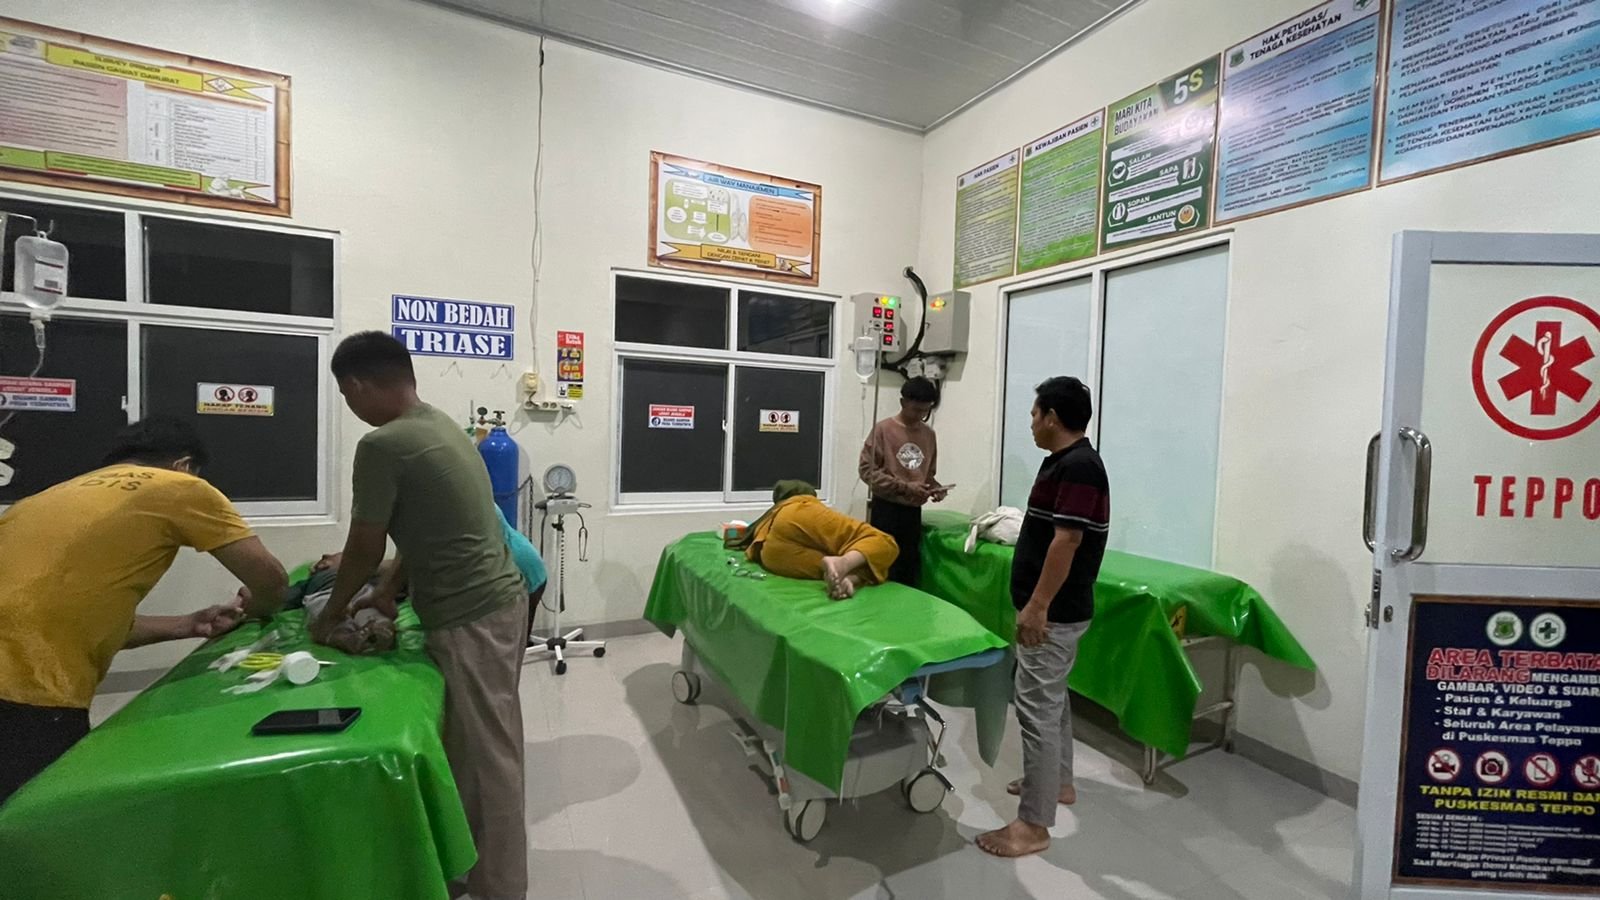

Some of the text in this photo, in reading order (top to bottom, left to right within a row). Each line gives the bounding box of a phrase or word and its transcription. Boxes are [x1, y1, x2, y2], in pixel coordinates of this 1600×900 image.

[1250, 14, 1342, 60] TENAGA KESEHATAN
[1262, 8, 1328, 46] HAK PETUGAS/
[1454, 28, 1505, 50] KESEHATAN
[1512, 16, 1538, 29] ATAU
[1173, 68, 1204, 105] 5S
[1444, 87, 1488, 105] DOKUMEN
[1115, 97, 1152, 122] MARI KITA
[1398, 94, 1444, 112] MEMBUAT
[1451, 85, 1472, 95] DAN
[1430, 108, 1447, 116] DAN
[1450, 93, 1494, 111] TINDAKAN
[1438, 112, 1481, 128] PENERIMA
[1488, 94, 1545, 114] PELAYANAN
[1394, 137, 1443, 155] KOMPETENSI
[1446, 132, 1464, 141] DAN
[1465, 113, 1532, 136] KEWENANGAN
[1535, 105, 1562, 117] YANG
[1407, 132, 1437, 144] TENAGA
[1441, 117, 1491, 135] KESEHATAN
[1494, 111, 1514, 120] LAIN
[1519, 102, 1546, 113] YANG
[1035, 122, 1088, 151] KEWAJIBAN PASIEN
[1160, 165, 1178, 176] SAPA
[1128, 196, 1150, 207] SOPAN
[1148, 210, 1176, 222] SANTUN
[397, 298, 510, 328] NON BEDAH
[401, 328, 506, 356] TRIASE
[1473, 475, 1600, 520] TEPPO
[1428, 648, 1494, 666] AREA
[1426, 665, 1530, 683] DILARANG
[1437, 682, 1600, 696] GAMBAR, VIDEO & SUAR
[1445, 694, 1572, 708] Pasien & Keluarga
[1443, 718, 1495, 730] Seluruh
[1498, 720, 1532, 731] Area
[1444, 706, 1560, 721] Staf & Karyawan
[1442, 732, 1582, 746] di Puskesmas Teppo
[1420, 786, 1472, 796] TANPA
[1477, 788, 1511, 798] IZIN
[1516, 790, 1568, 800] RESMI
[1434, 799, 1595, 815] PUSKESMAS TEPPO
